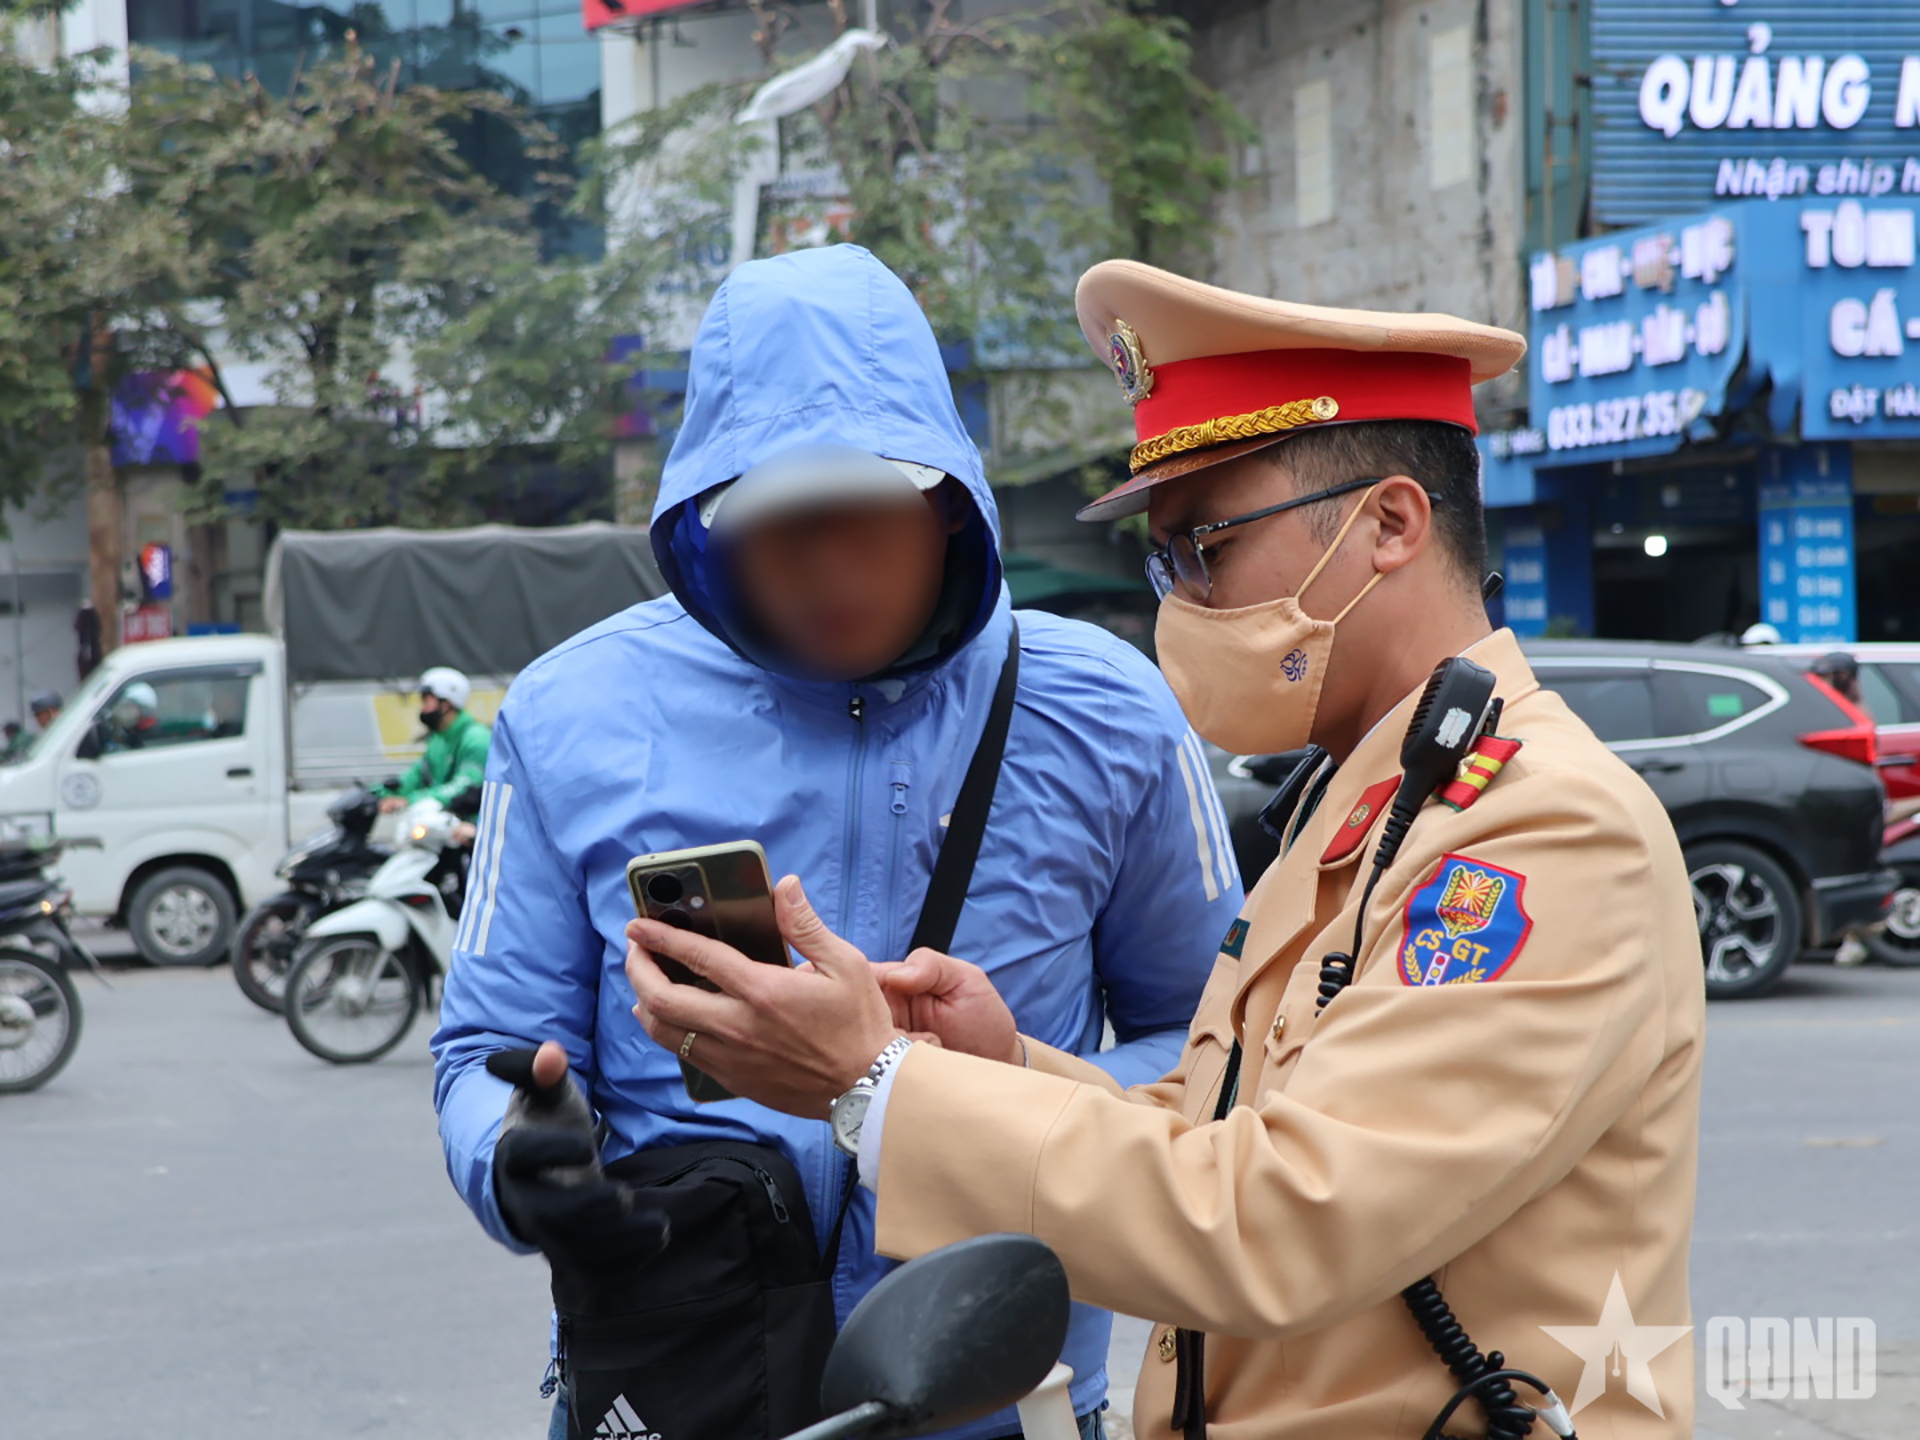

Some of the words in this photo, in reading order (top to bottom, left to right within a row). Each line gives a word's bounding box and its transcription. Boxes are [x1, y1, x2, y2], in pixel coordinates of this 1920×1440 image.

[1639, 21, 1872, 138] QUẢNG
[1715, 156, 1809, 201] Nhận
[1816, 156, 1895, 198] ship
